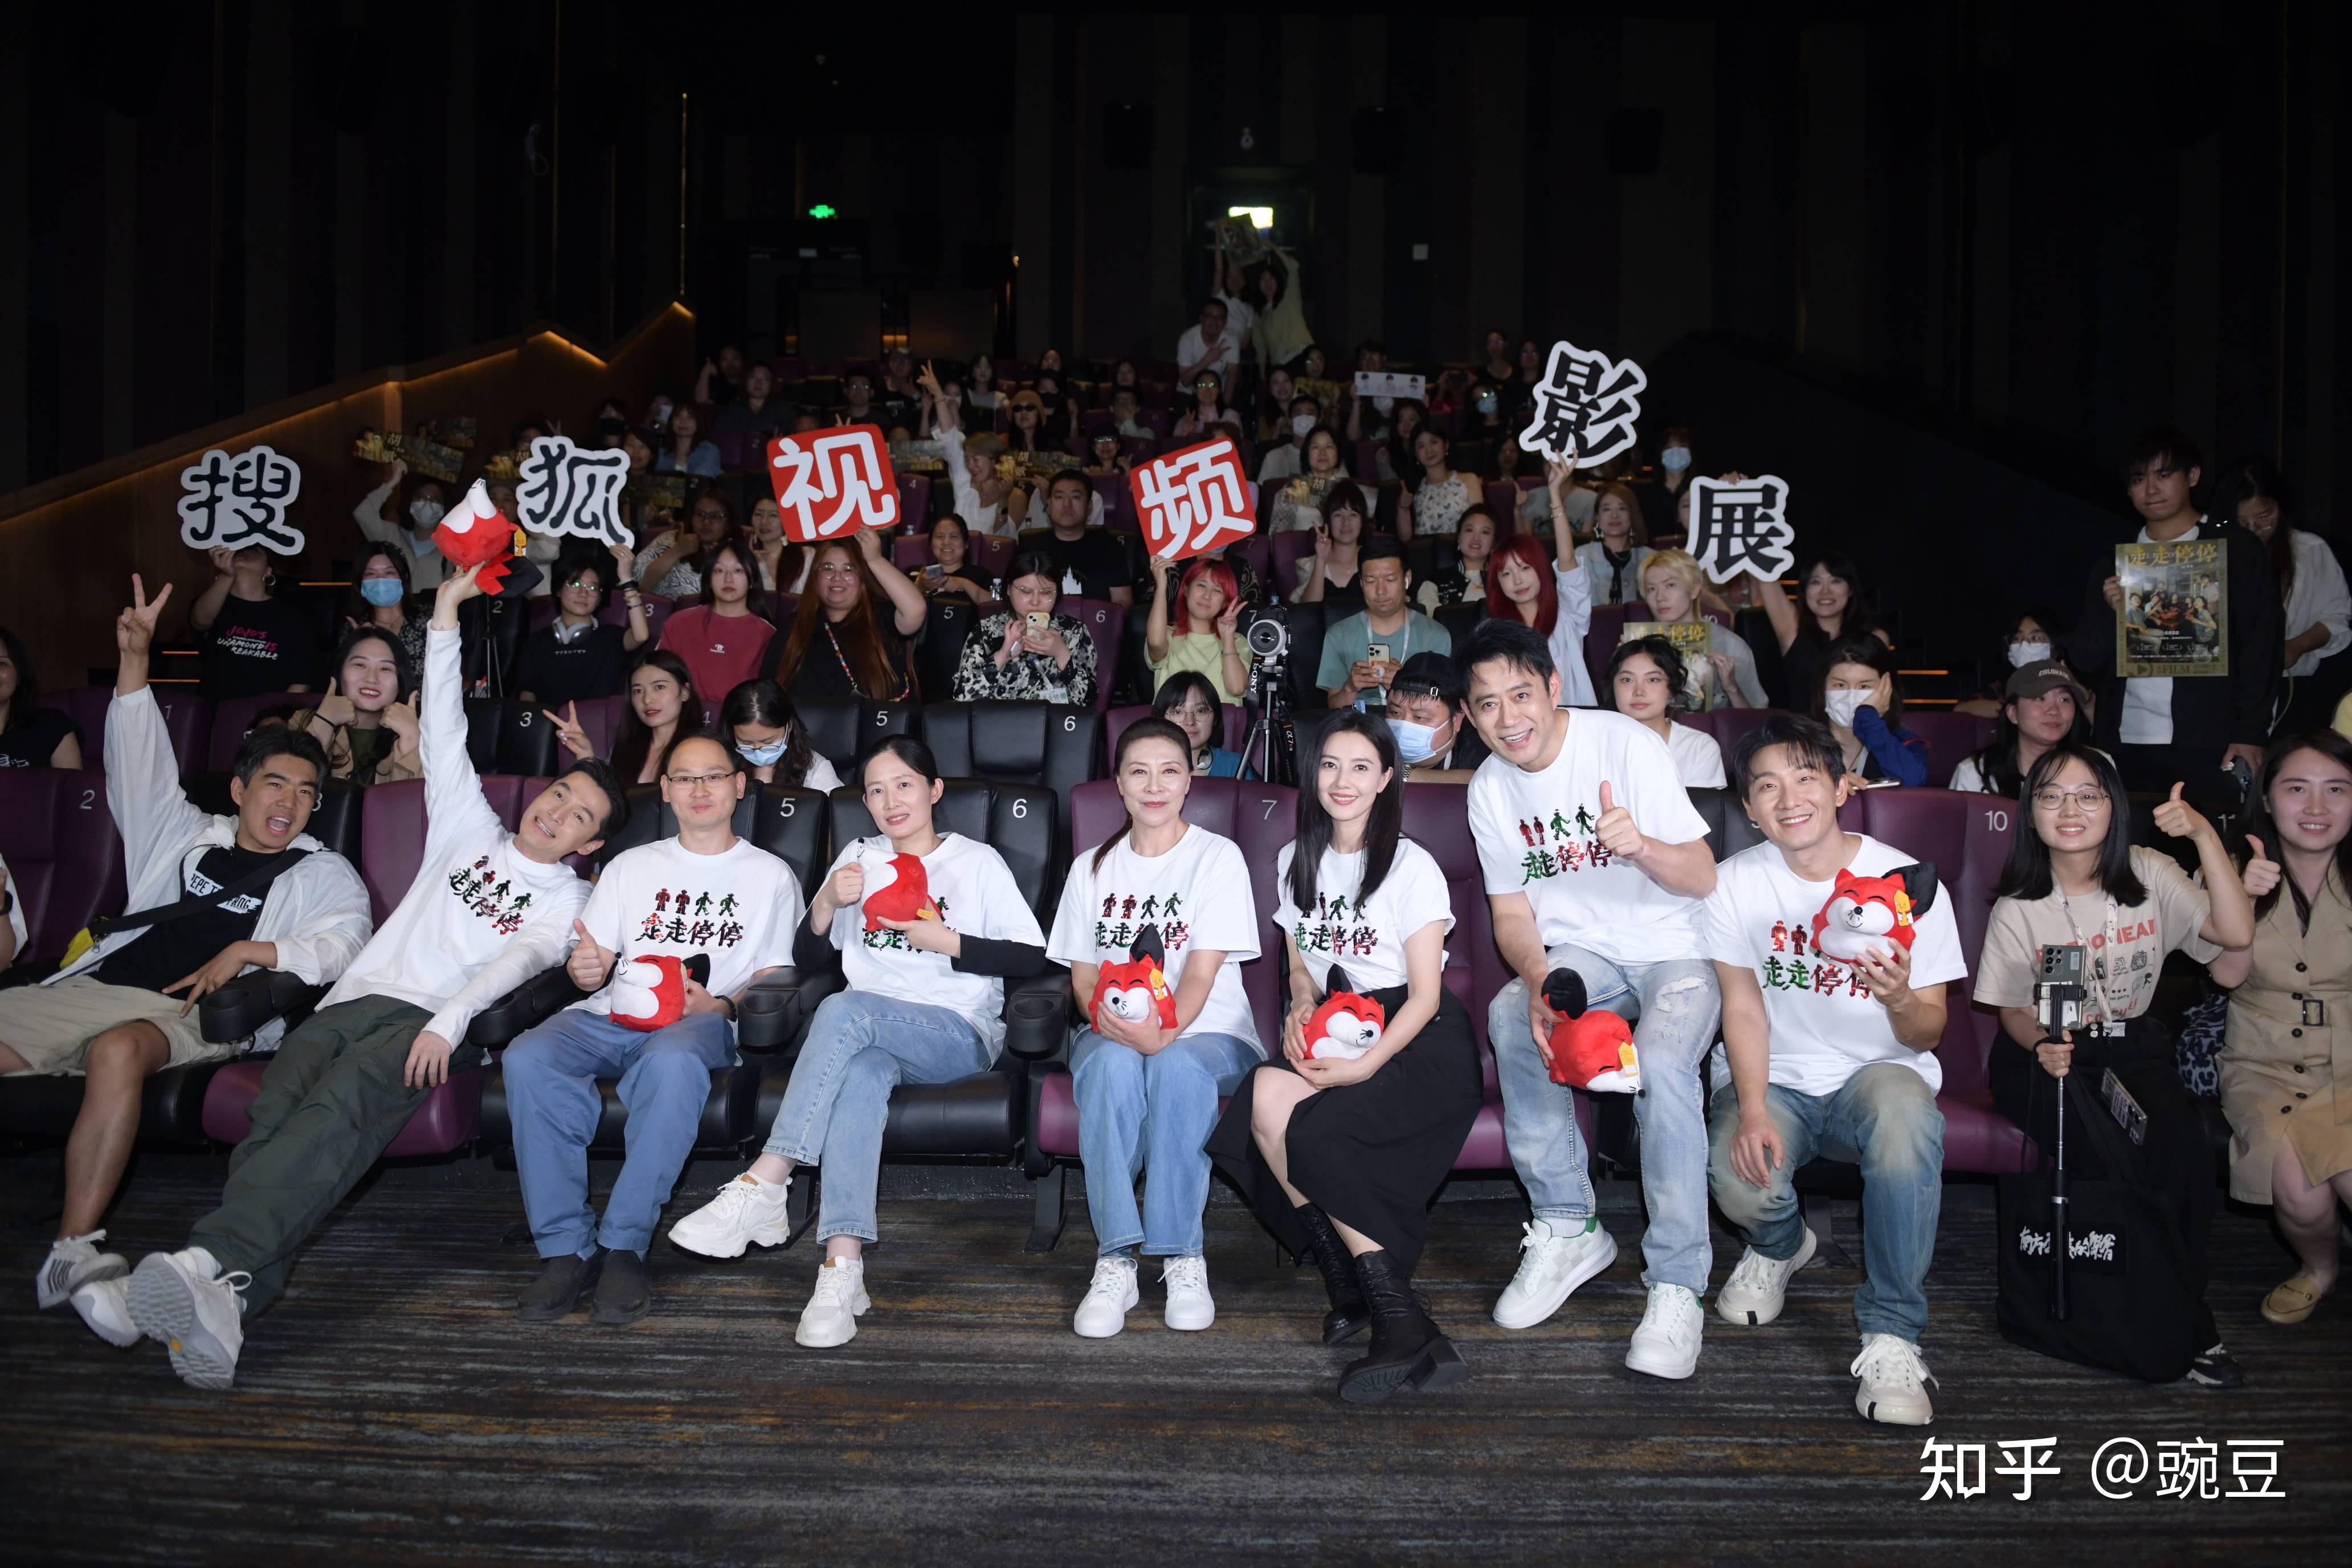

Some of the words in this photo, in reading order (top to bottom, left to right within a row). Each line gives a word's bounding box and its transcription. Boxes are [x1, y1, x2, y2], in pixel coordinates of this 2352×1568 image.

[1528, 351, 1638, 459] 影
[689, 479, 699, 488] 2
[774, 431, 896, 540] 视
[909, 479, 917, 489] 4
[187, 453, 296, 548] 搜
[525, 443, 626, 544] 狐
[1140, 441, 1254, 560] 频
[1692, 484, 1785, 574] 展
[992, 541, 1001, 552] 5
[1247, 538, 1255, 550] 7
[2129, 543, 2218, 566] 走走停停
[492, 601, 503, 614] 2
[646, 604, 654, 616] 3
[944, 607, 954, 620] 5
[1096, 610, 1106, 622] 6
[1249, 610, 1257, 623] 7
[2163, 664, 2190, 674] FILM
[1251, 663, 1259, 694] SONY
[165, 704, 172, 720] 1
[520, 711, 532, 728] 3
[702, 711, 710, 726] 4
[876, 711, 888, 726] 5
[1064, 716, 1076, 731] 6
[79, 790, 95, 810] 2
[780, 798, 795, 818] 5
[1013, 799, 1027, 818] 6
[1262, 800, 1277, 820] 7
[1985, 811, 2008, 831] 10
[635, 913, 744, 948] 走走停停
[1095, 918, 1189, 953] 走走停
